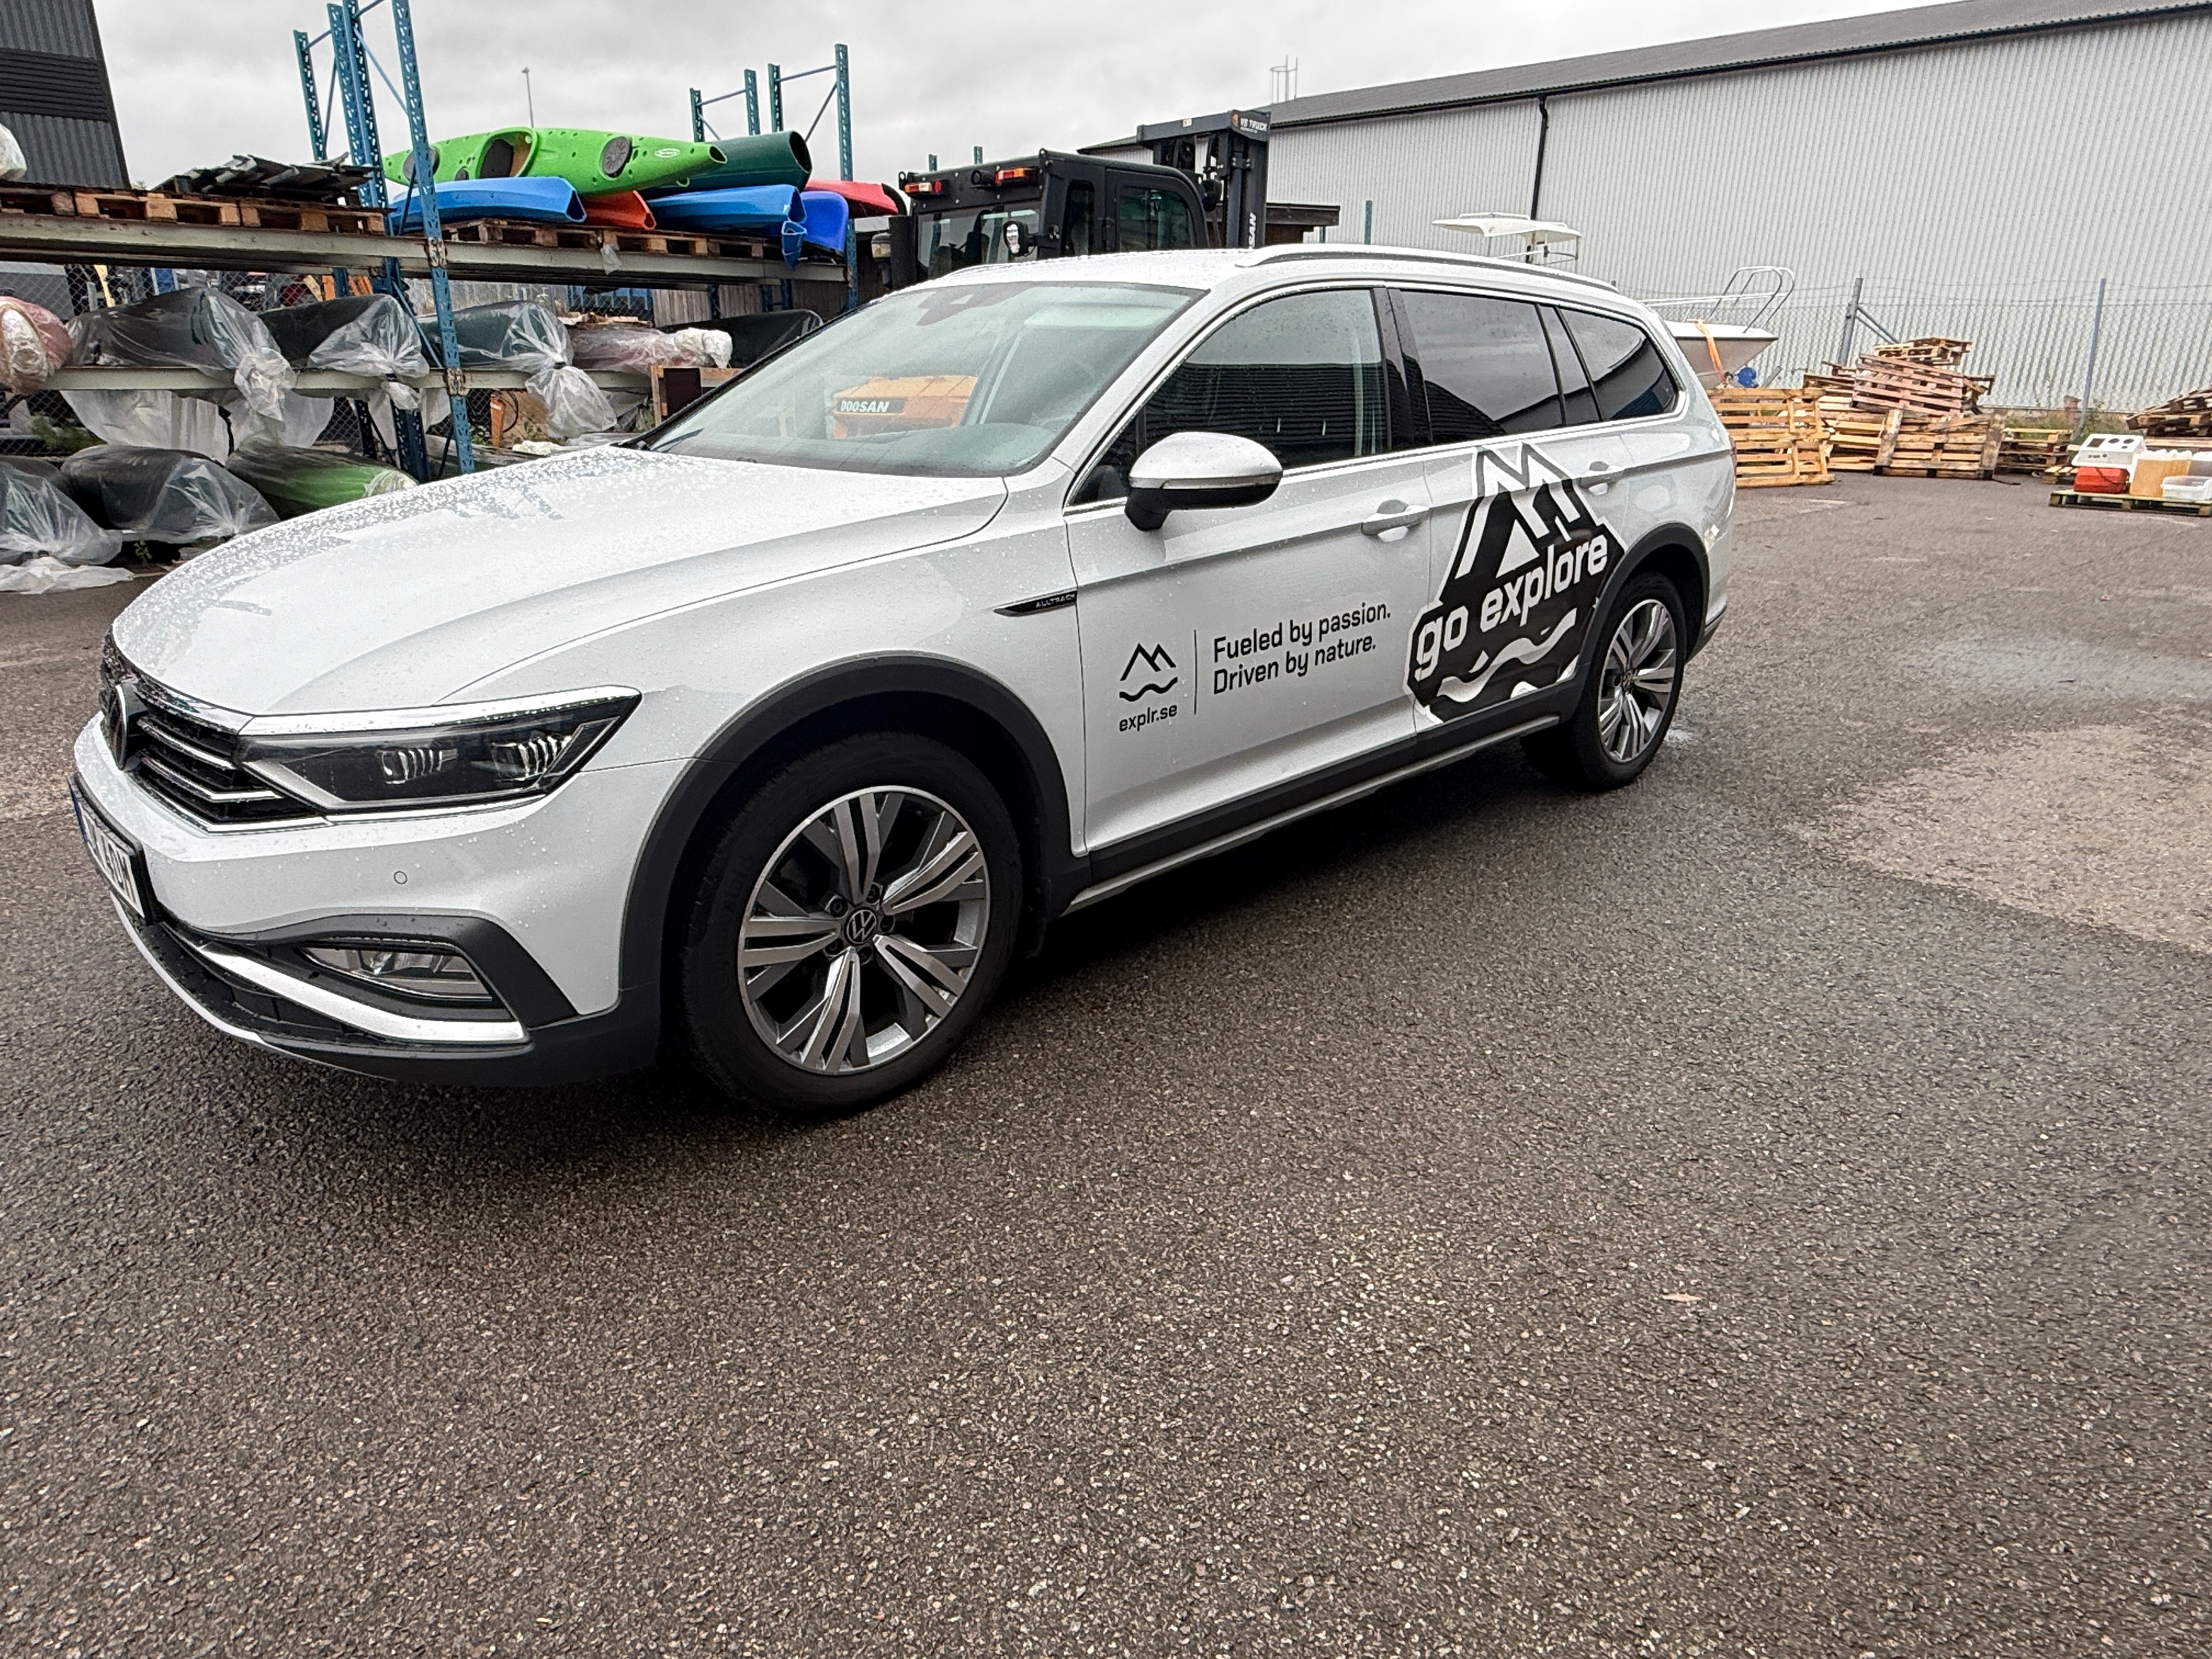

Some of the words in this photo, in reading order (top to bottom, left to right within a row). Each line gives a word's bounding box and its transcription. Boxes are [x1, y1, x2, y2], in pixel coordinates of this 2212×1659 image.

[840, 400, 890, 413] DOOSAN
[1214, 622, 1283, 663] Fueled
[1289, 619, 1313, 646] by
[1319, 602, 1391, 642] passion.
[1414, 605, 1469, 682] go
[1480, 534, 1608, 633] explore
[1213, 661, 1279, 695] Driven
[1285, 651, 1309, 676] by
[1314, 635, 1376, 667] nature.
[1119, 704, 1178, 732] explr.se
